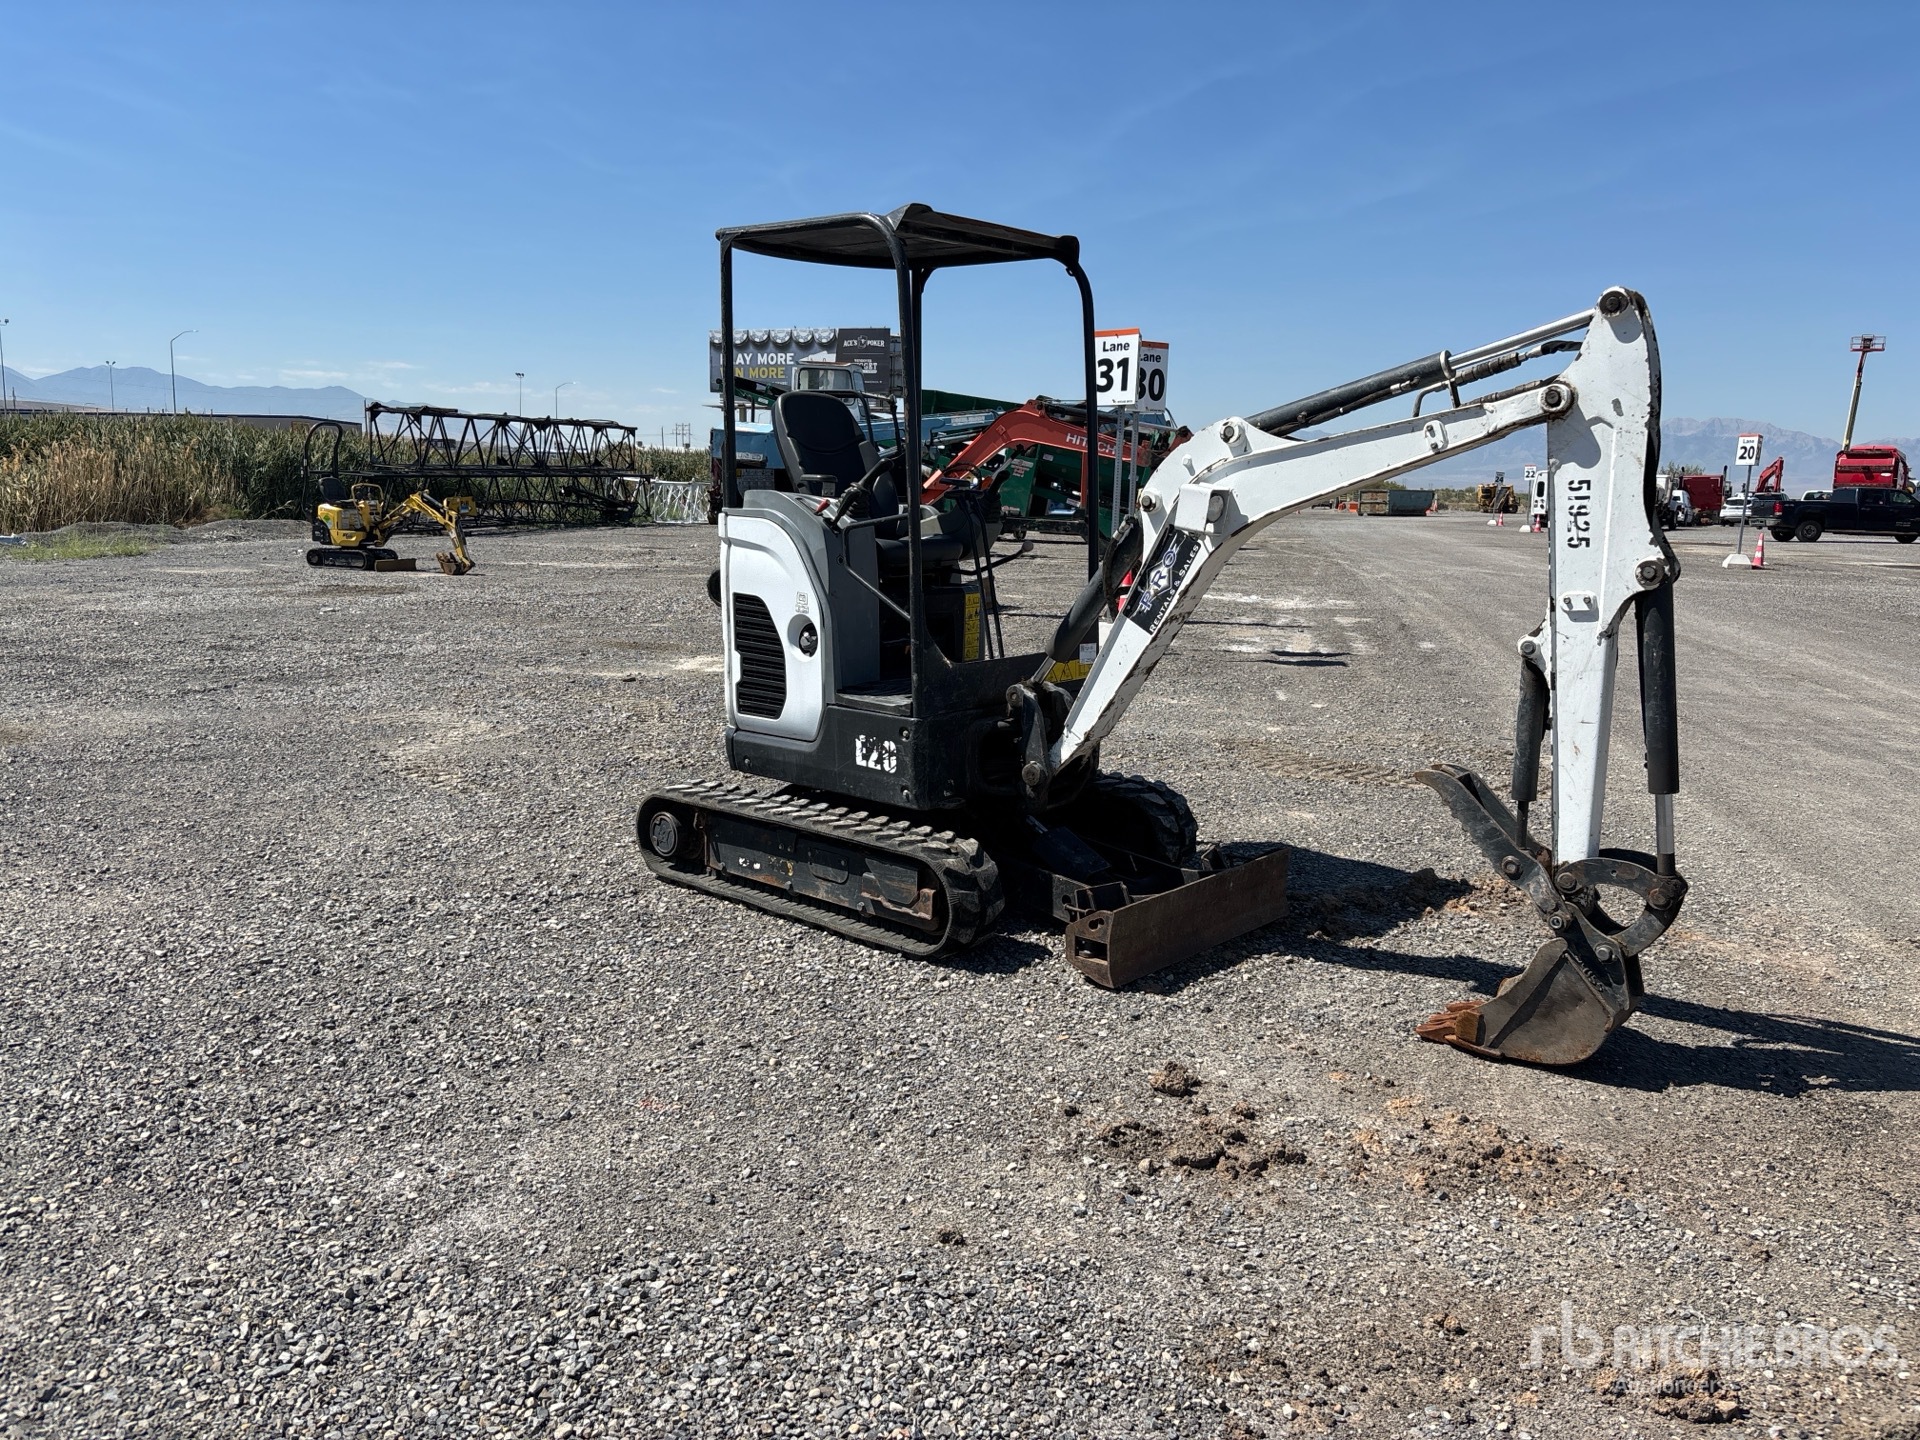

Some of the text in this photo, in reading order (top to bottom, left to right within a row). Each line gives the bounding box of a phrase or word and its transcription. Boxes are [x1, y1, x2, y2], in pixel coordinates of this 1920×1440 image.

[1102, 341, 1130, 352] Lane
[720, 353, 795, 365] AY MORE
[749, 367, 786, 379] MORE
[1096, 357, 1130, 393] 31
[1738, 445, 1755, 460] 20
[1525, 470, 1536, 478] 22
[1567, 480, 1591, 549] 51925
[1140, 548, 1178, 609] PRO
[1149, 544, 1200, 633] RENTALS & SALES
